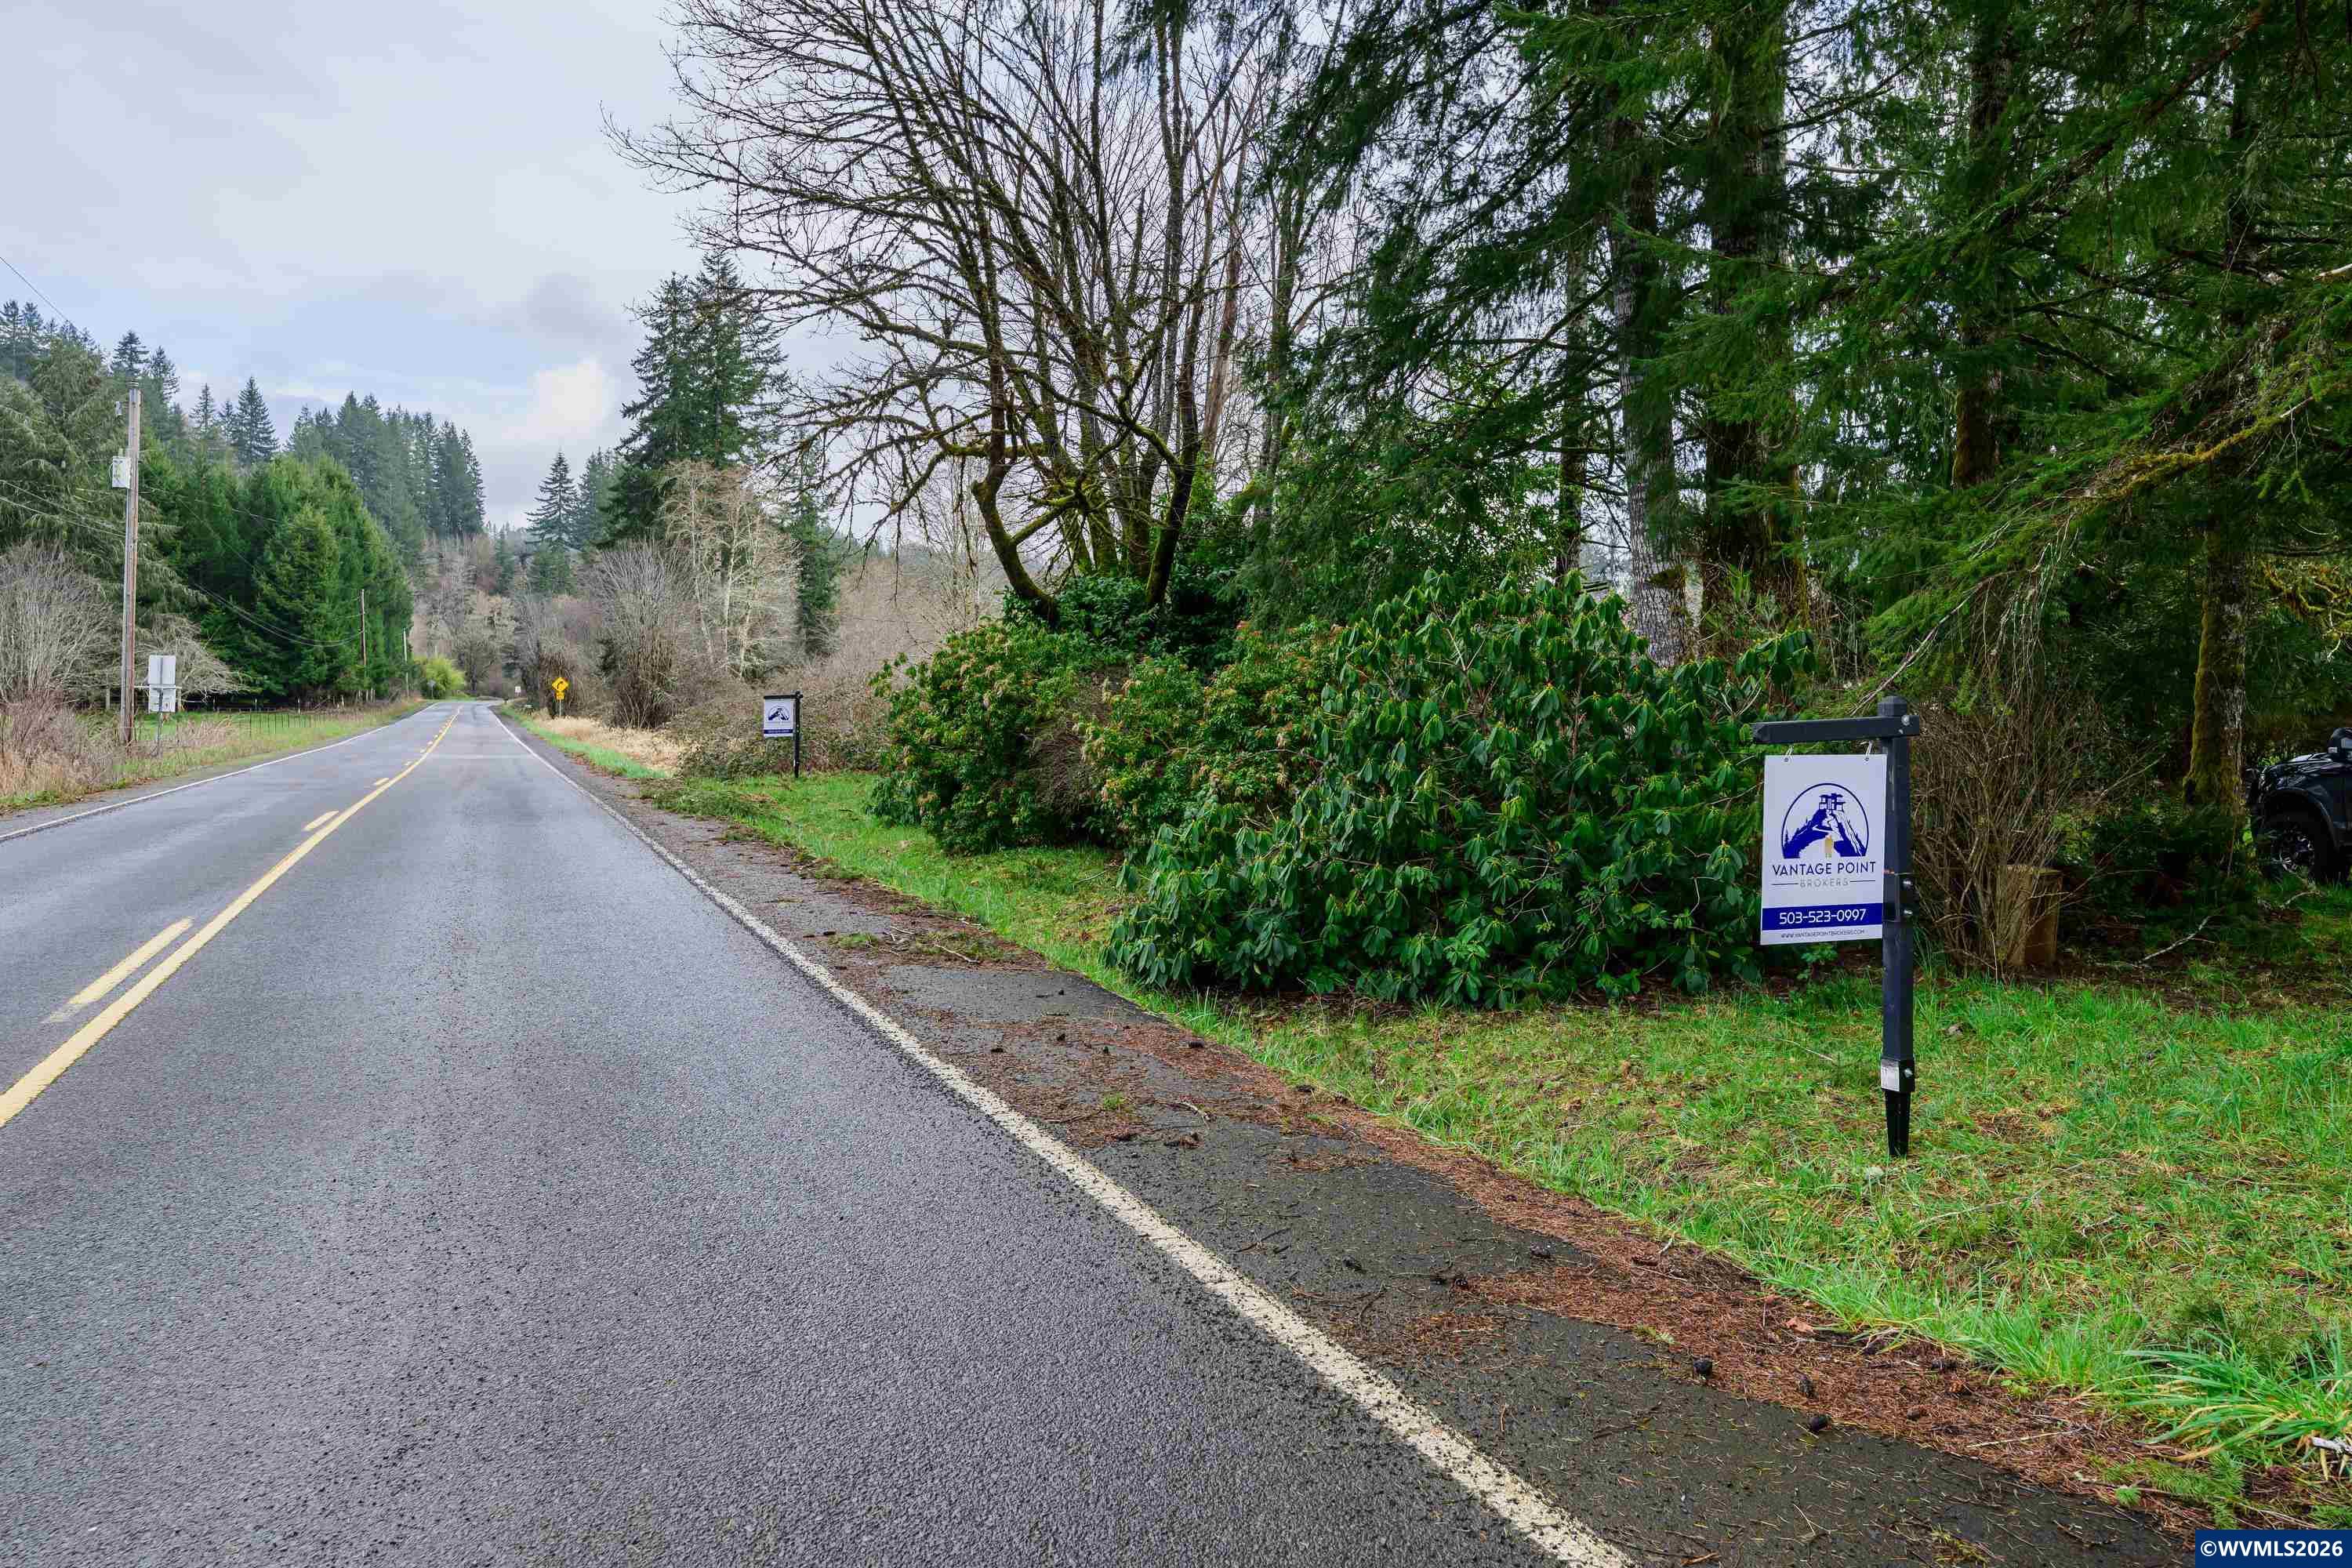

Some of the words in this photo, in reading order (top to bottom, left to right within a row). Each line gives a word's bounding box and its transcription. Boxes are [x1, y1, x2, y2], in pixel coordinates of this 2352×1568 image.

[1772, 863, 1832, 876] VANTAGE
[1838, 862, 1876, 874] POINT
[1799, 878, 1849, 887] BROKERS
[1779, 909, 1867, 924] 503-523-0997
